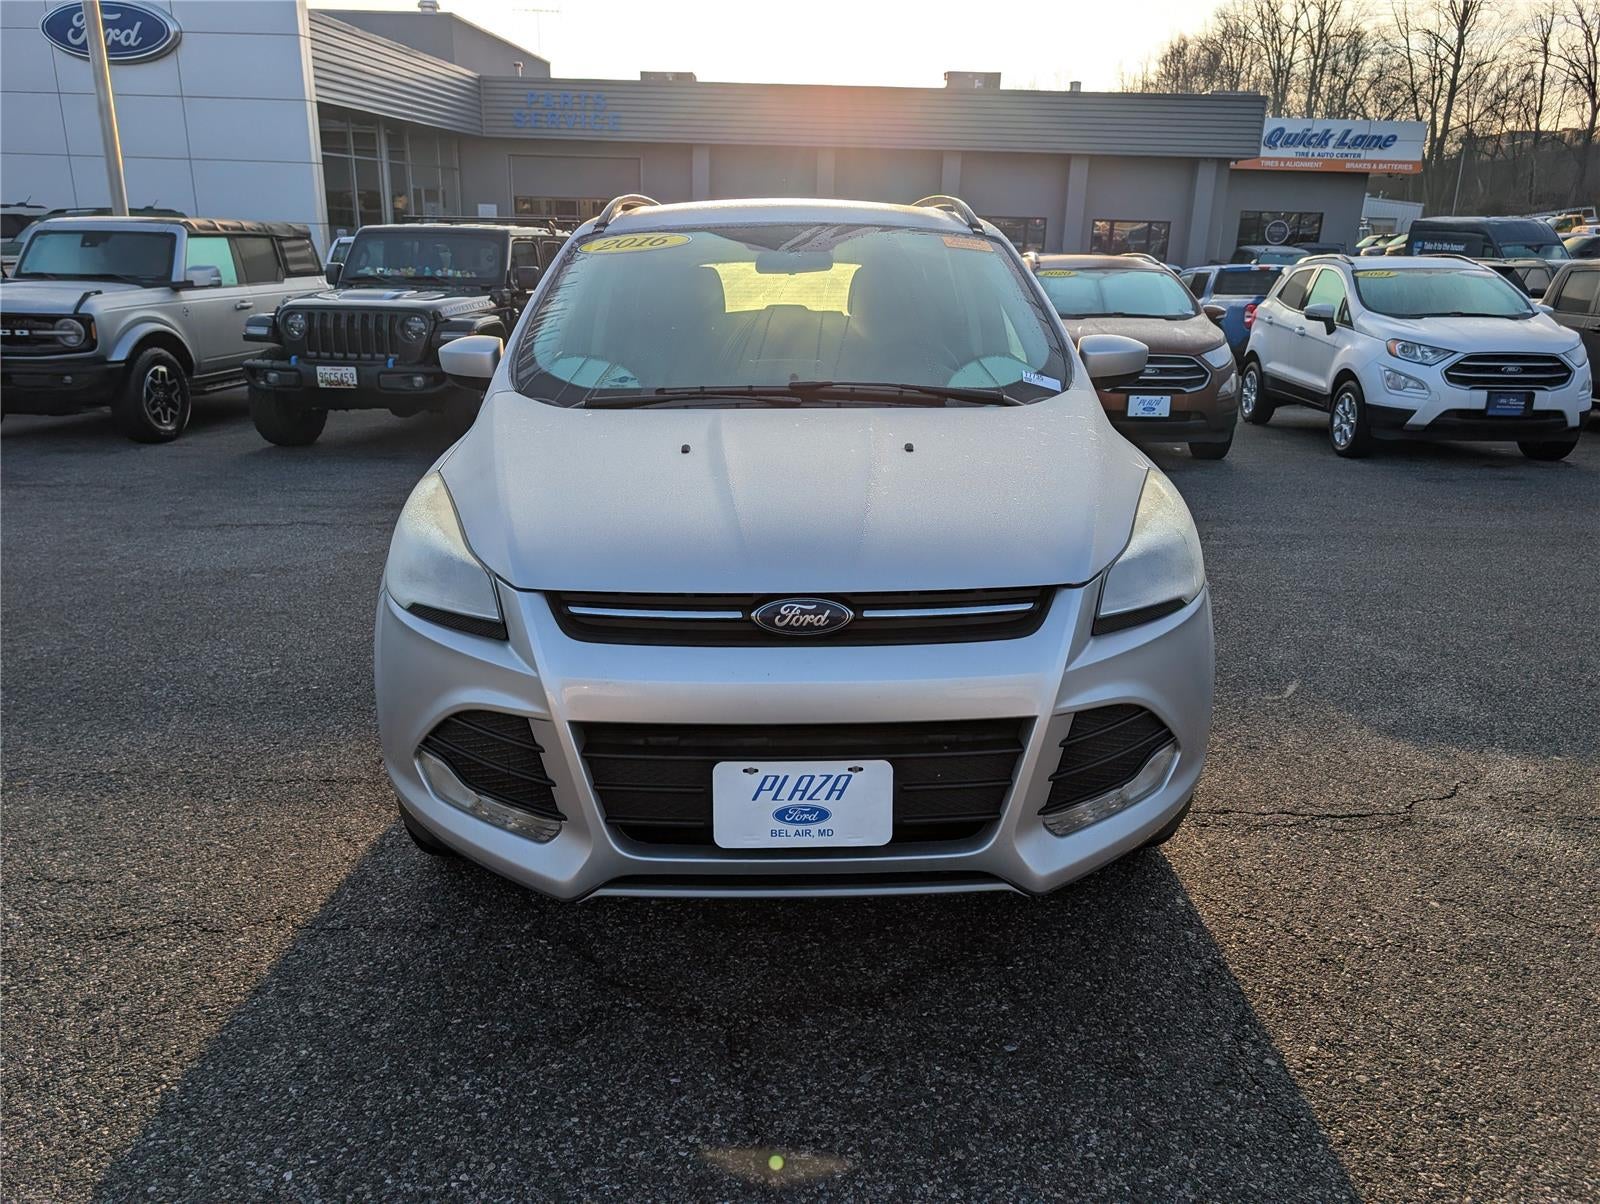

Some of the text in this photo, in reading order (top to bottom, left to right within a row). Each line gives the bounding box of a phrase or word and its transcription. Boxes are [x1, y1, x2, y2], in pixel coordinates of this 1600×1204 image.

[67, 12, 142, 48] Frd
[527, 91, 608, 110] PARTS
[513, 109, 623, 131] SERVICE
[1263, 126, 1398, 150] Quick Lane
[1286, 161, 1323, 169] ALIGNMENT
[595, 235, 669, 251] 2016
[774, 603, 831, 628] Ford
[751, 774, 853, 802] PLAZA
[784, 807, 819, 822] Ford
[770, 828, 834, 839] BEL AIR, MD
